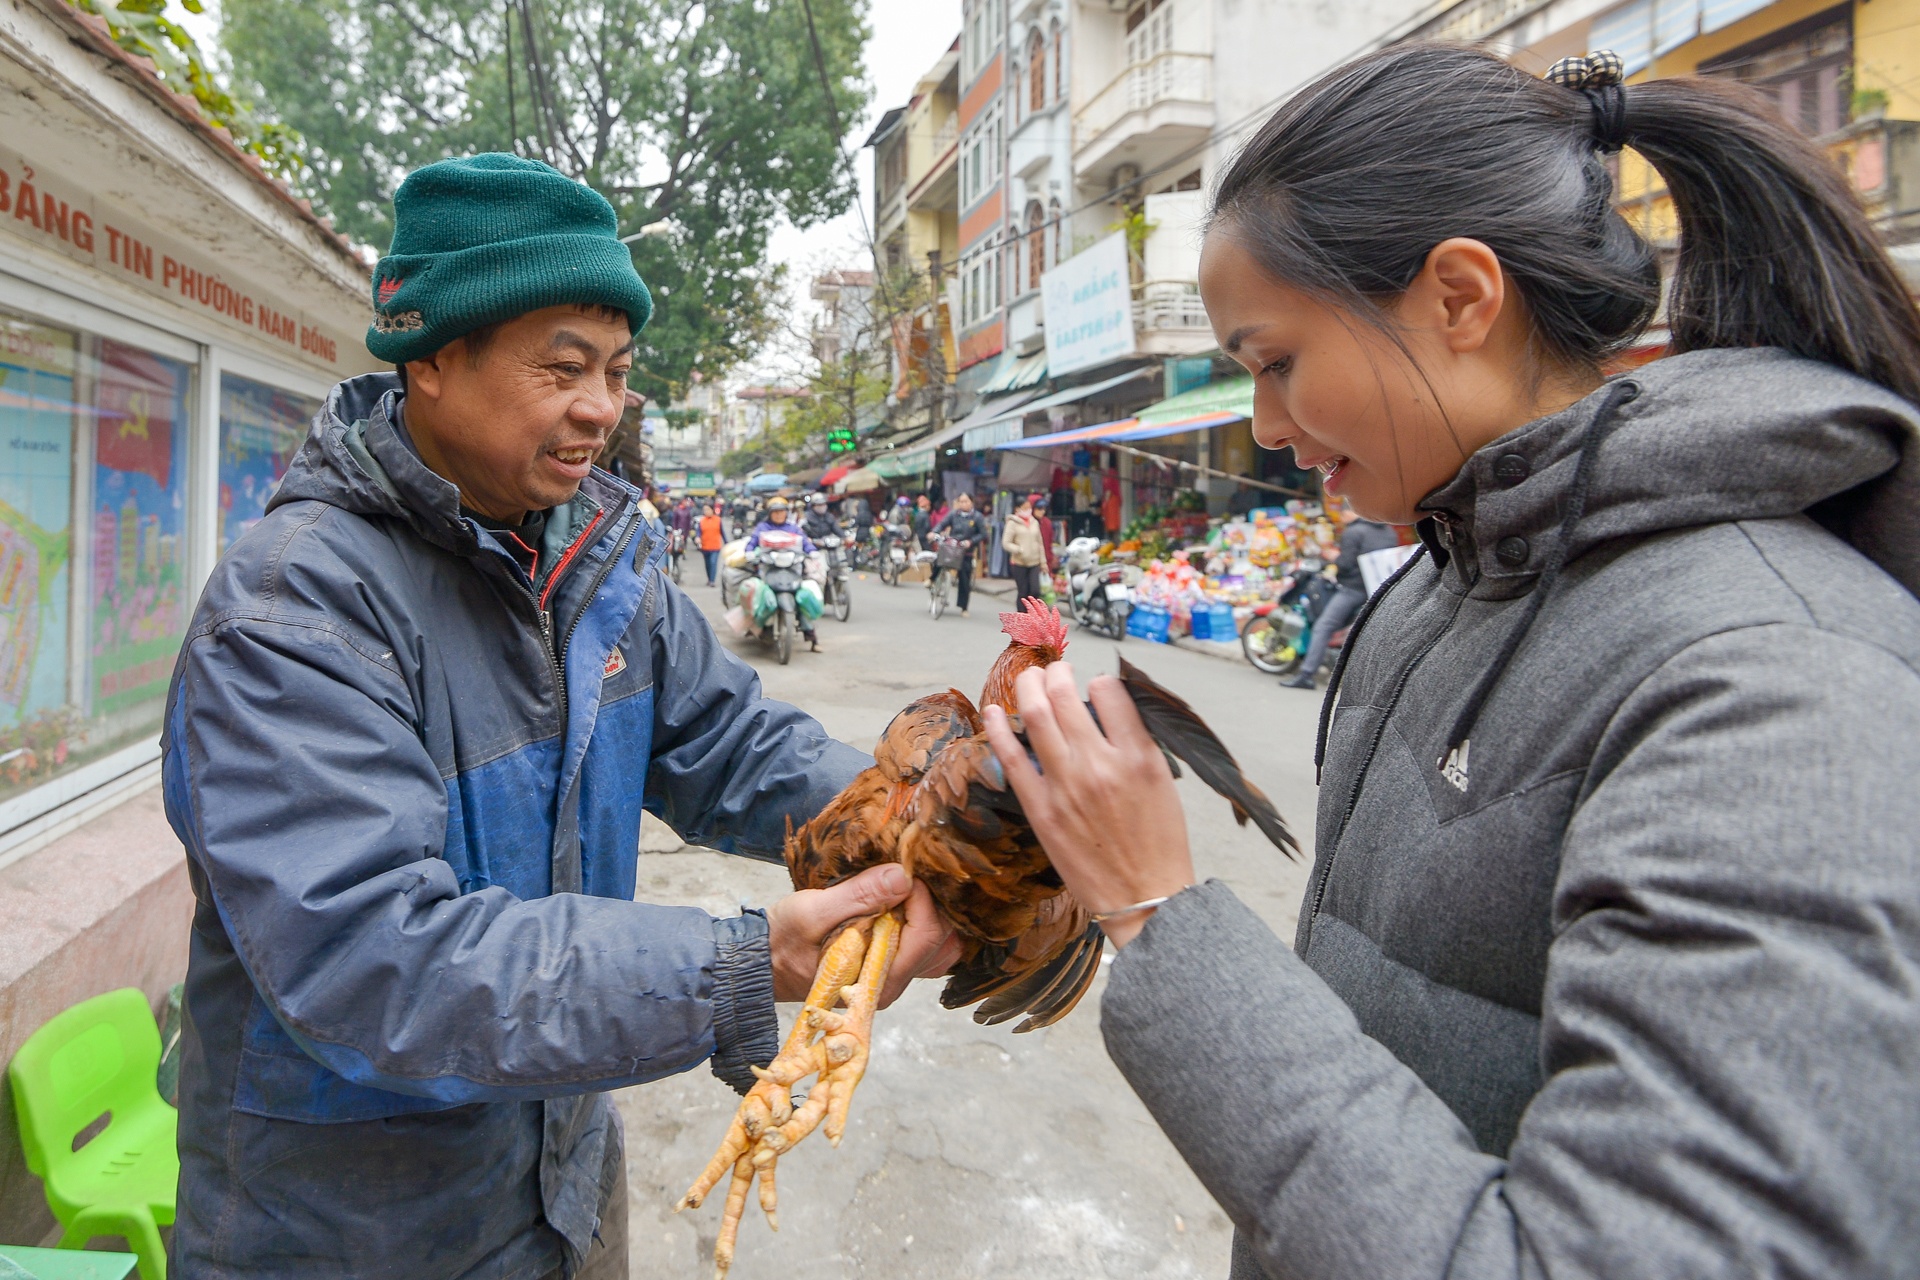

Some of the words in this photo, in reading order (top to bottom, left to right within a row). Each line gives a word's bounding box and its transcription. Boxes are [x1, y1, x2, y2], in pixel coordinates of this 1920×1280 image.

[0, 165, 94, 254] BẢNG
[104, 223, 153, 281] TIN
[259, 304, 296, 346] NAM
